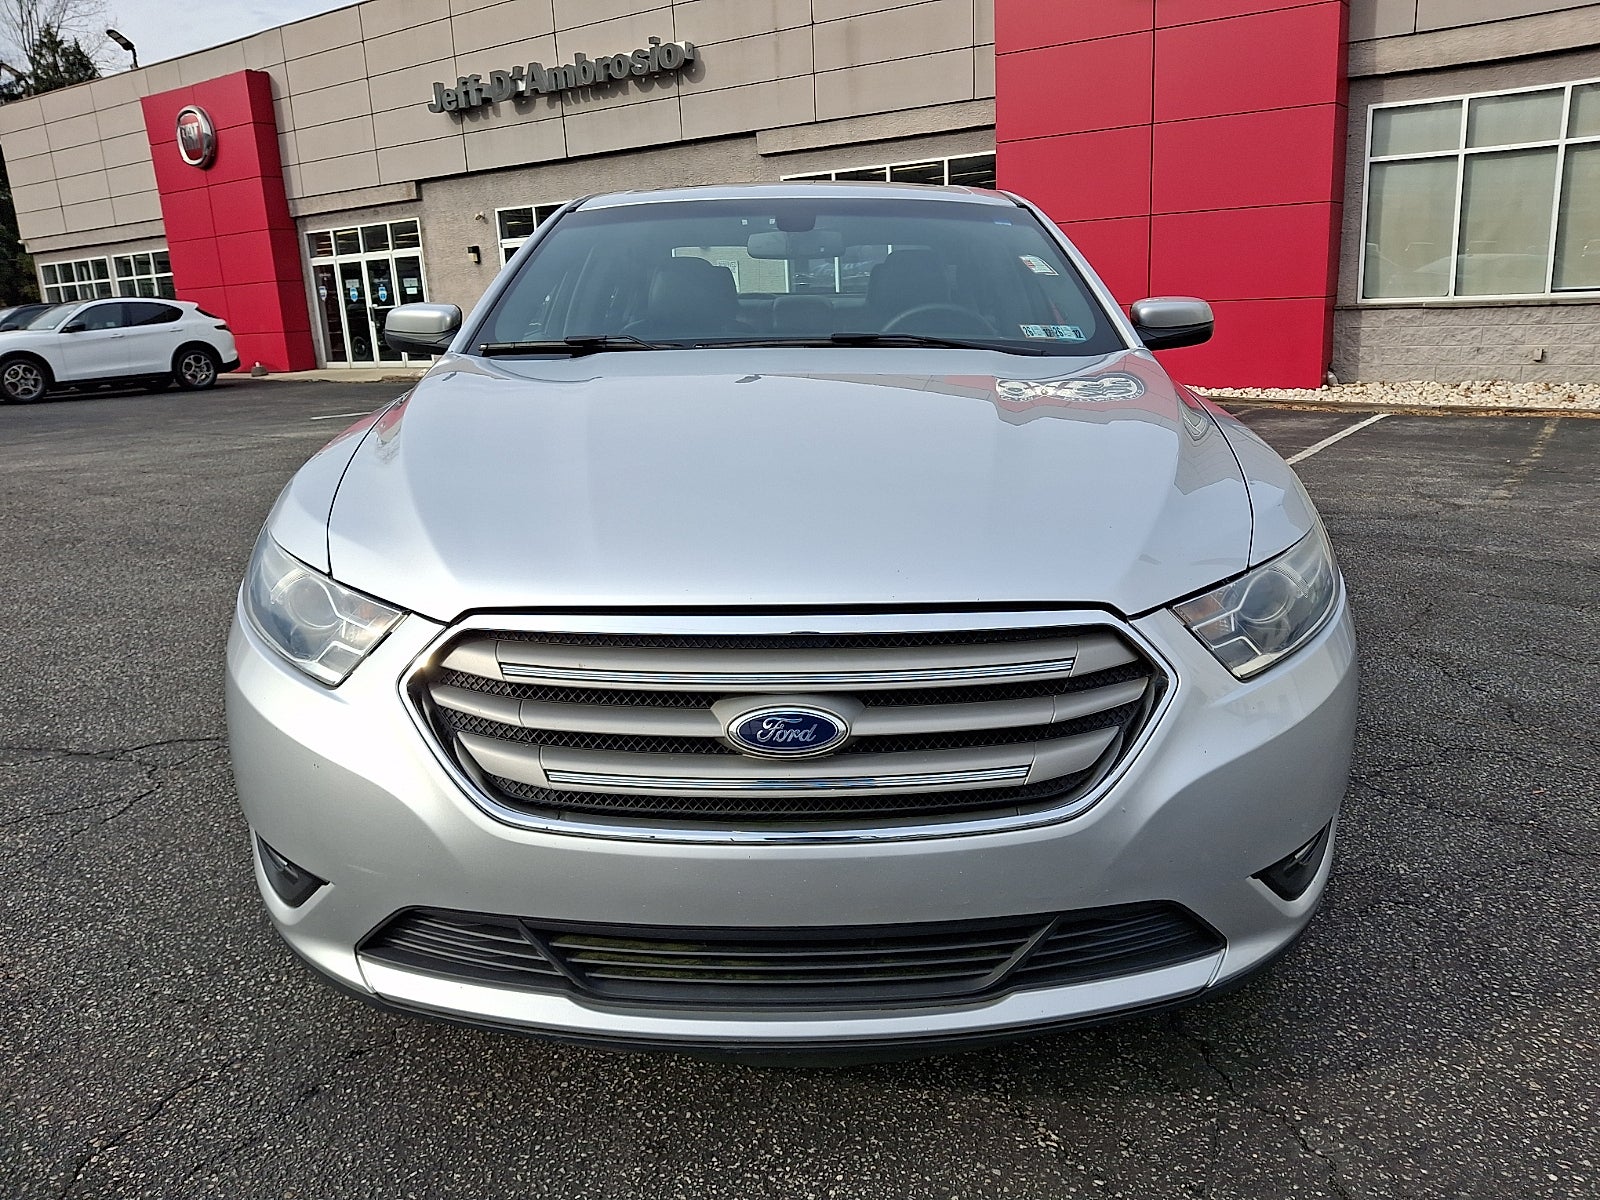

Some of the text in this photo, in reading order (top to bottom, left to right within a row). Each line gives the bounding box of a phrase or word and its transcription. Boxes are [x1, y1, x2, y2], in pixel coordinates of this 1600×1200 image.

[428, 36, 685, 113] Jeff D'Ambrosio
[756, 716, 818, 742] Ford
